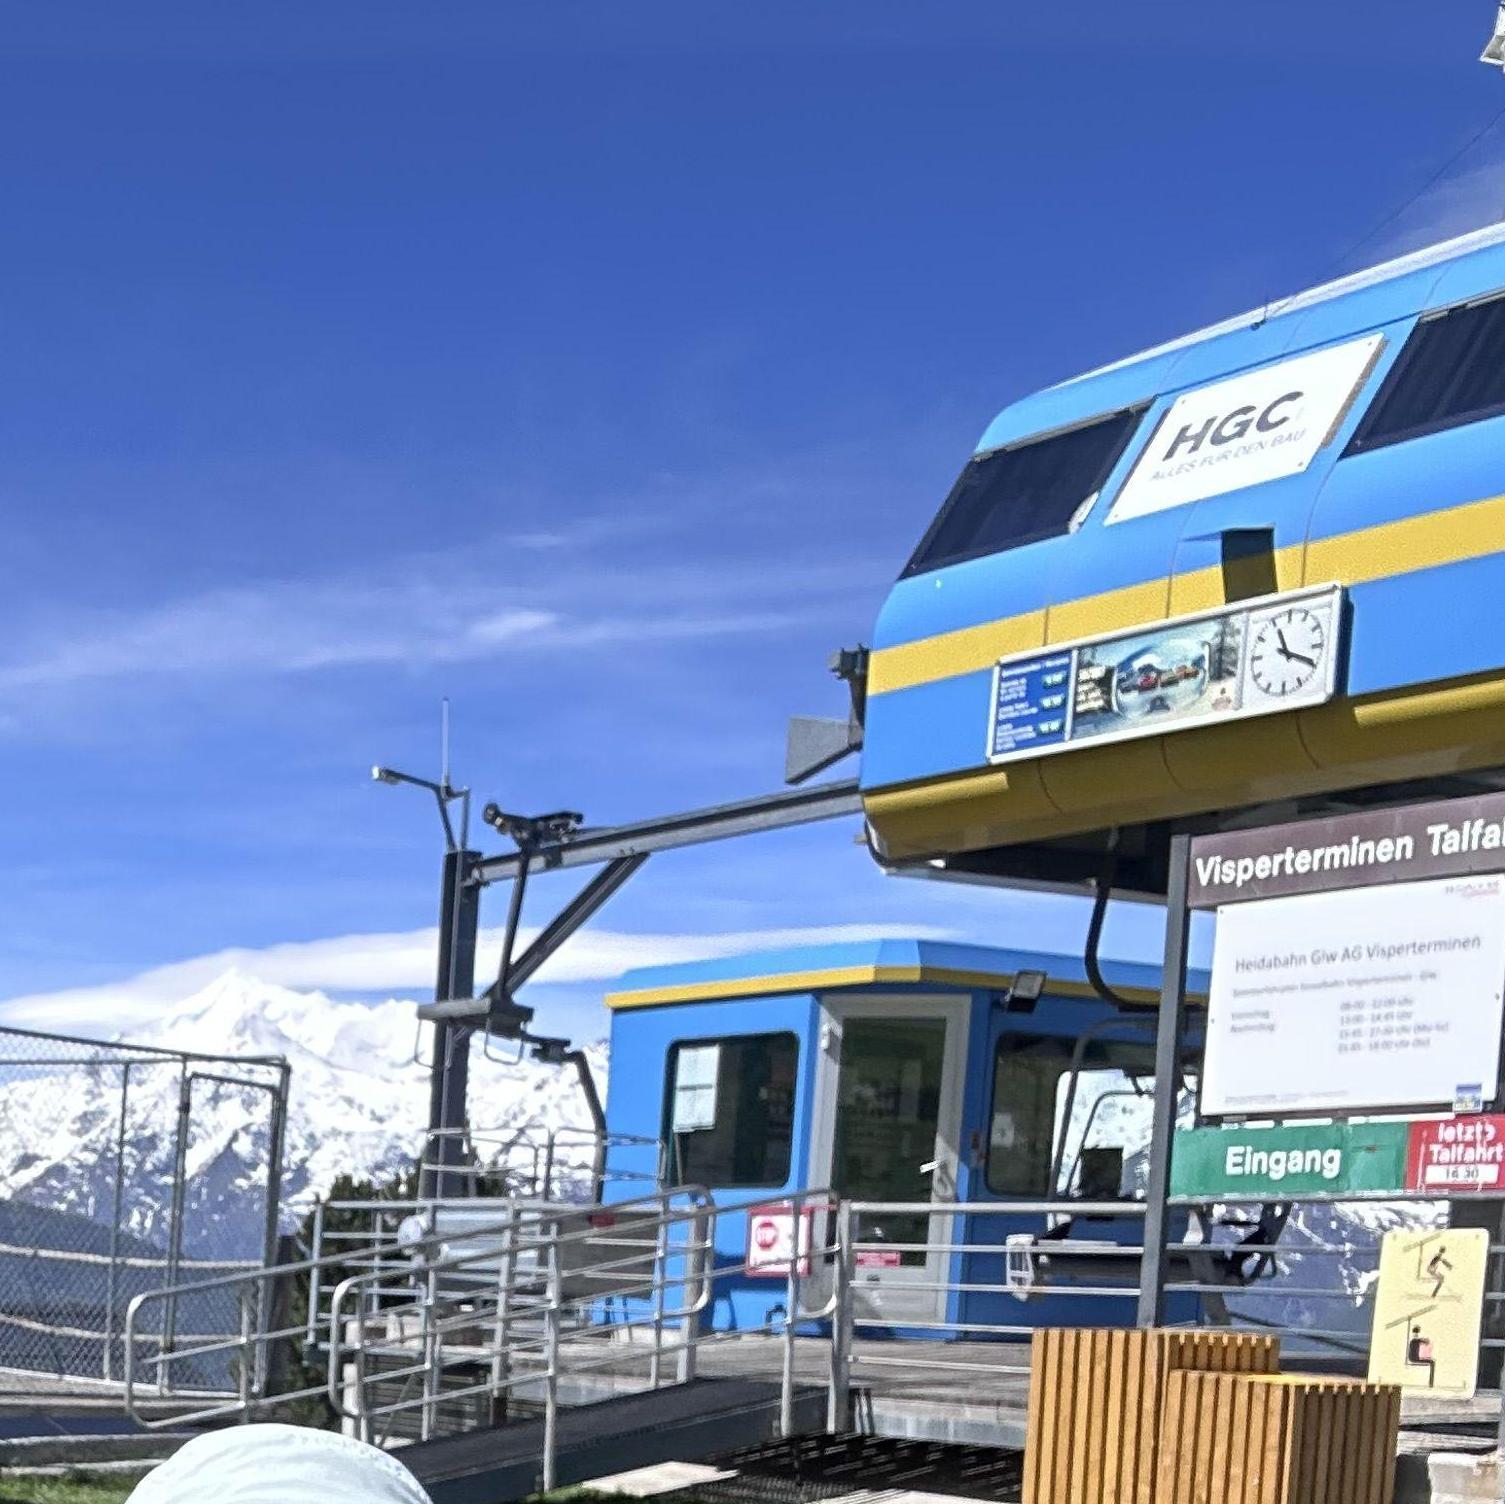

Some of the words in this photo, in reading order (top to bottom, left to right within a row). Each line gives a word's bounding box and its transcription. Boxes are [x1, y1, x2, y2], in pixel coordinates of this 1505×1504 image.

[1161, 391, 1304, 462] HGC
[1270, 428, 1306, 448] BAU
[1196, 835, 1415, 887] Visperterminen
[1235, 953, 1307, 973] Heidabahn
[1341, 945, 1363, 962] AG
[1366, 935, 1481, 961] Visperterminen
[1225, 1145, 1342, 1180] Eingang
[1429, 1142, 1503, 1164] Talfahrt
